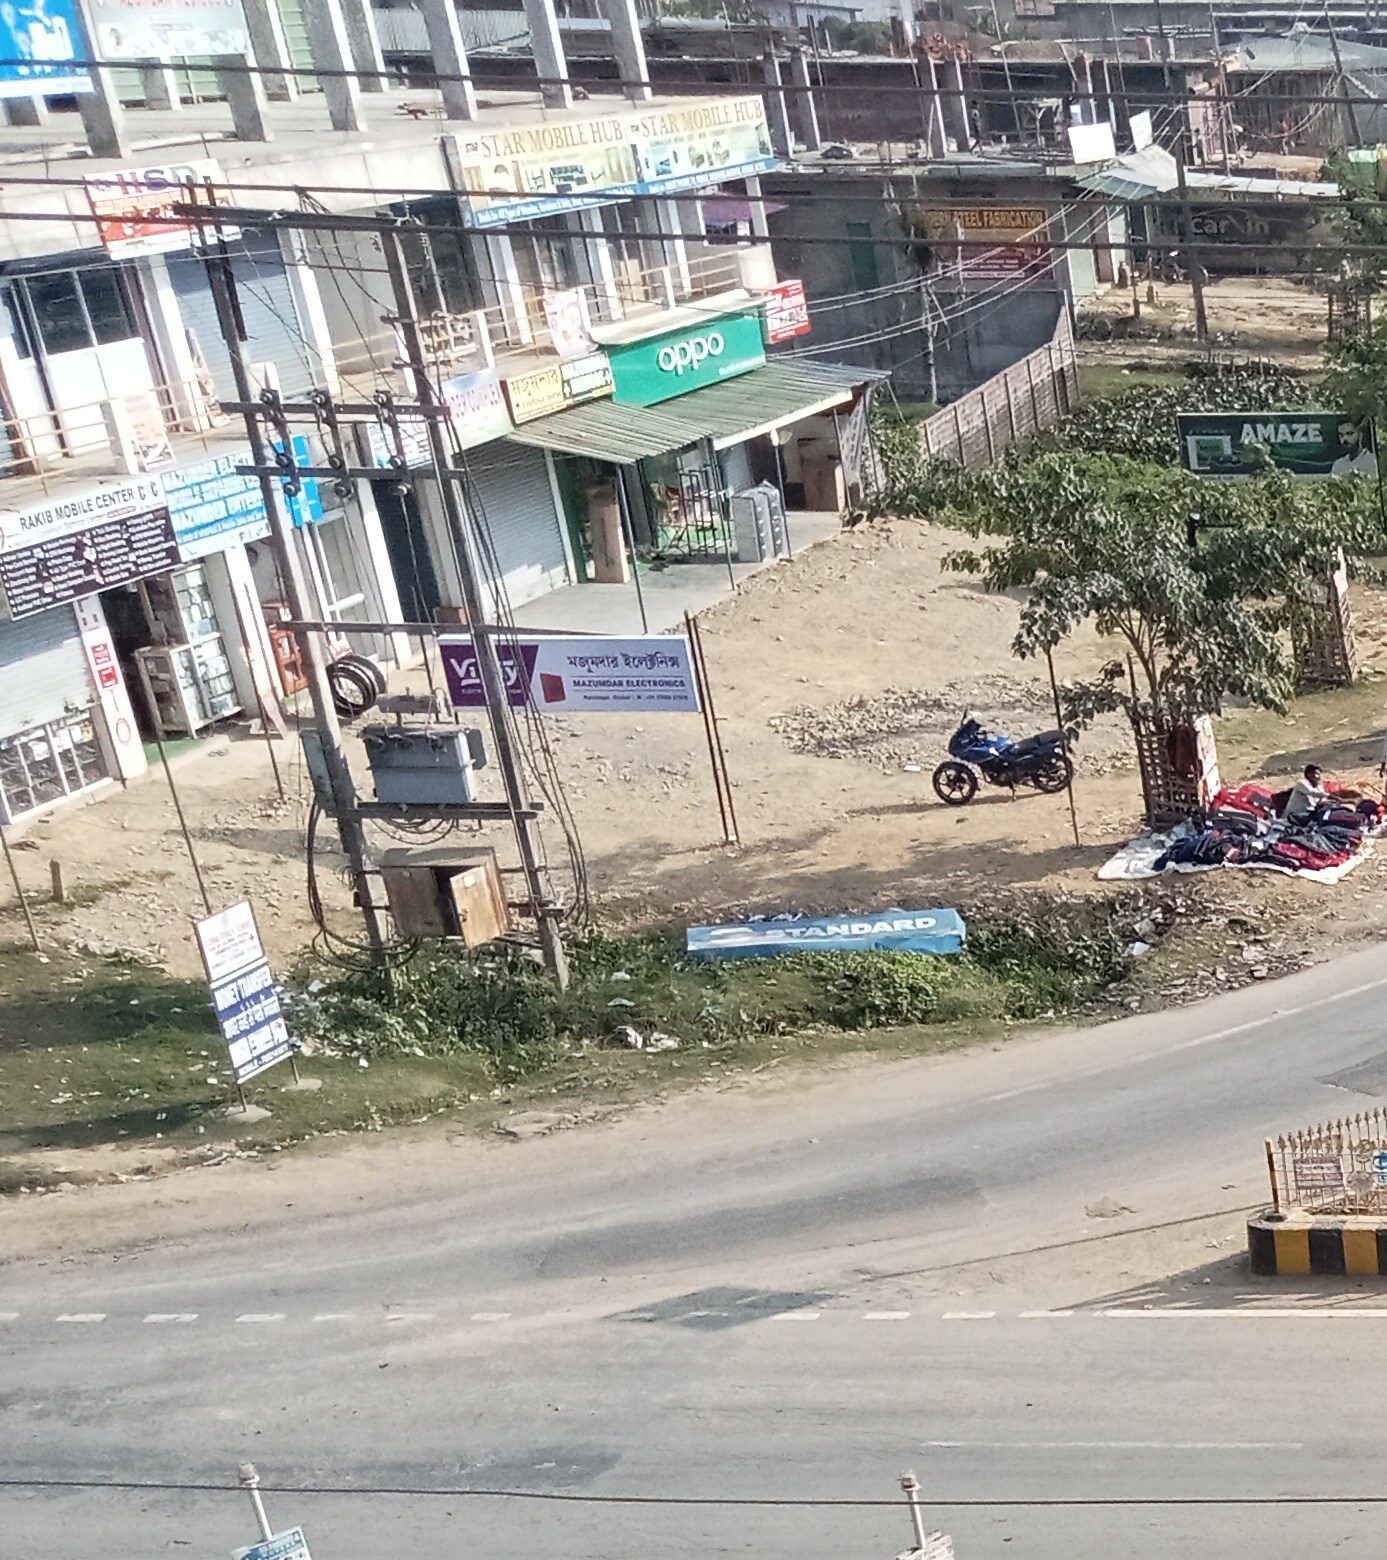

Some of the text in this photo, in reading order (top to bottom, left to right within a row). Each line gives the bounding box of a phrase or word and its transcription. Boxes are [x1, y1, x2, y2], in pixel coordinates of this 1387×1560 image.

[642, 99, 763, 138] STAR MOBILE HUB
[480, 130, 527, 159] STAR
[528, 123, 588, 152] MOBILE
[590, 118, 624, 143] HUB
[1240, 423, 1324, 443] AMAZE
[20, 509, 53, 531] RAKIB
[55, 499, 94, 521] MOBILE
[96, 487, 135, 509] CENTER
[573, 679, 685, 688] MAZUMDAR ELECTRONICS
[765, 917, 937, 939] STANDARD
